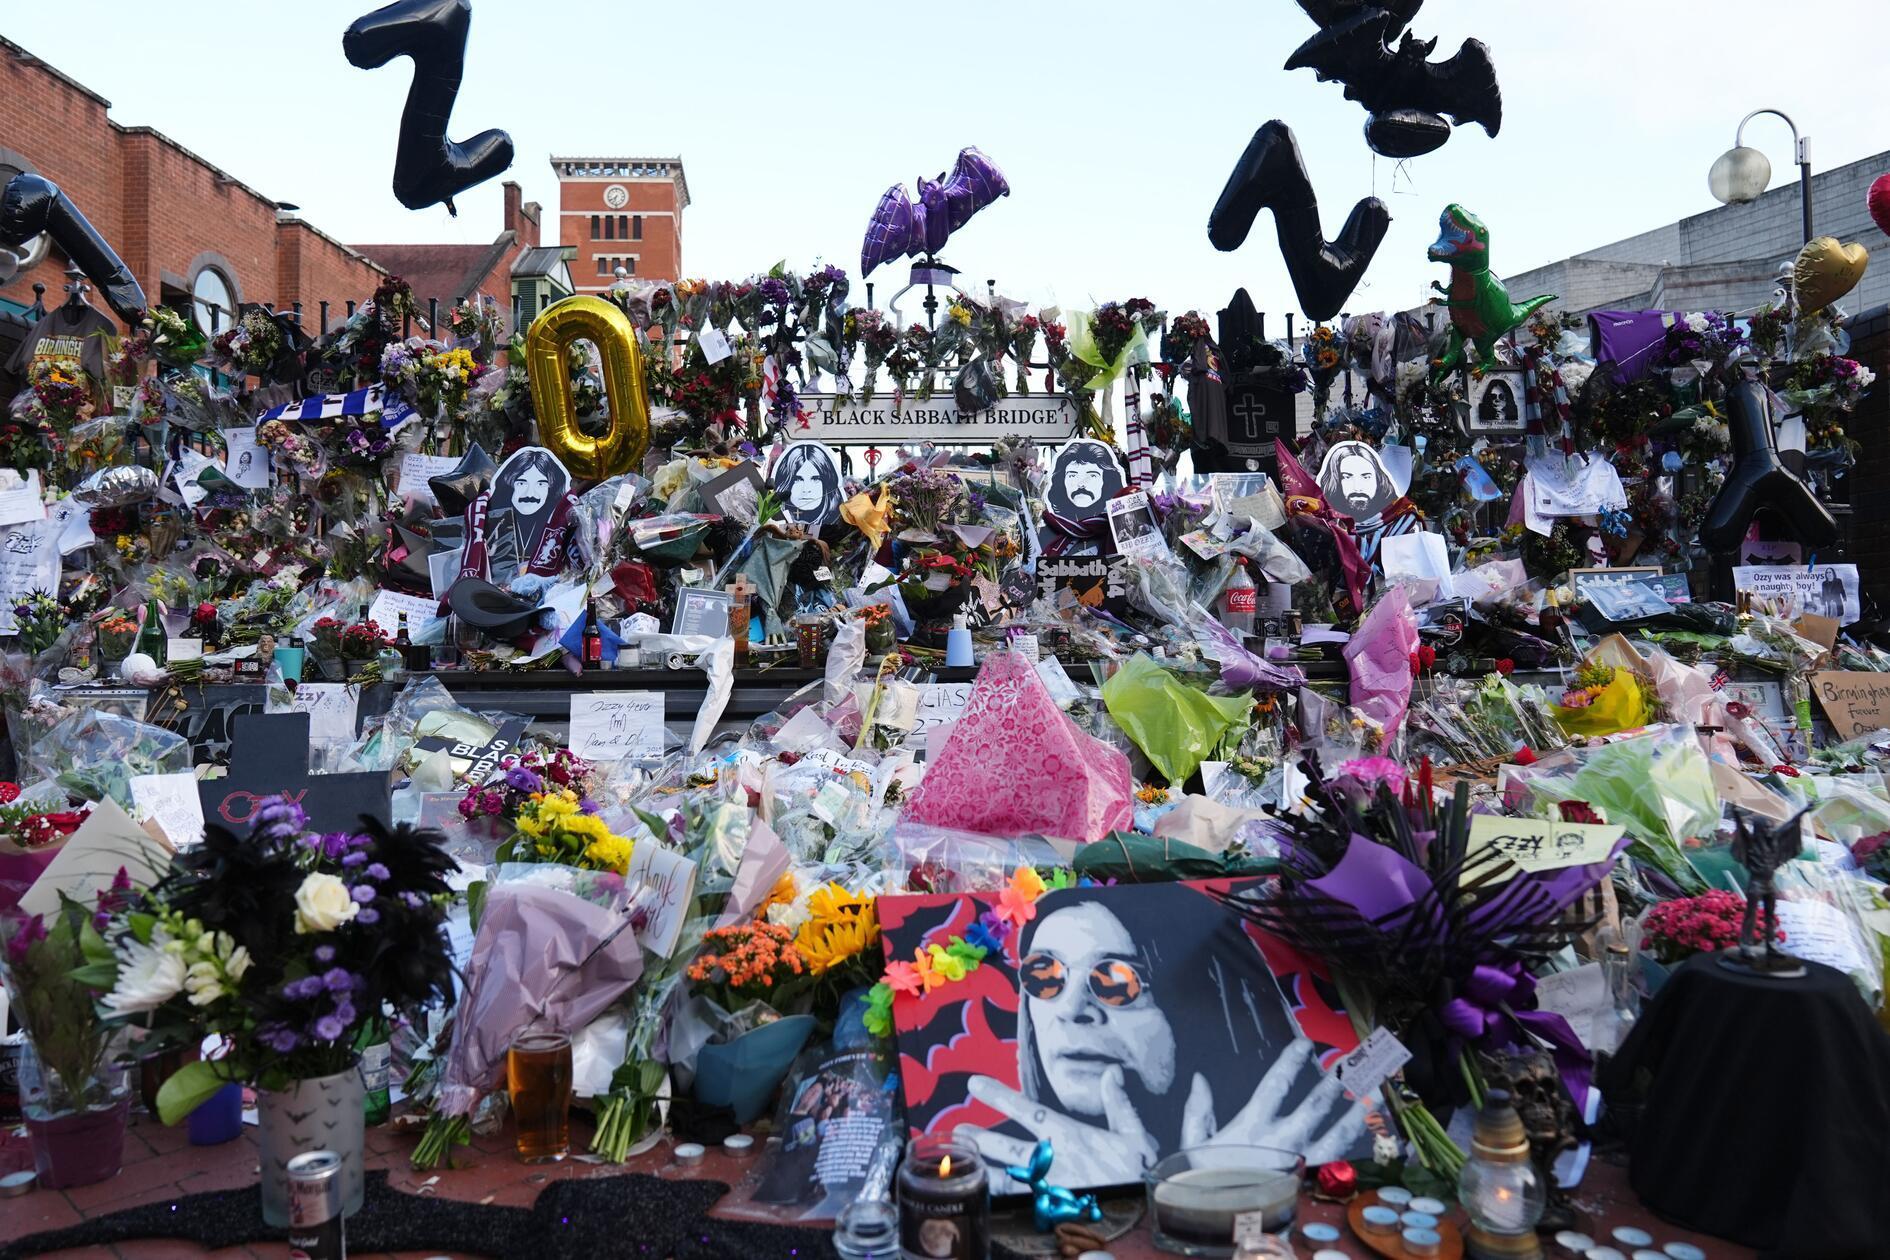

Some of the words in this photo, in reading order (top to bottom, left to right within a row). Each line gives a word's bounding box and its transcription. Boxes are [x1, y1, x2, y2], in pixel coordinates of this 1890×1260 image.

[823, 409, 886, 426] BLACK
[890, 409, 978, 426] SABBATH
[985, 409, 1058, 426] BRIDGE
[1037, 559, 1108, 577] Sabbath
[1753, 573, 1772, 582] Ozzy
[1796, 572, 1825, 582] always
[1760, 582, 1793, 592] naughty
[1796, 581, 1816, 592] boy!
[589, 700, 623, 714] Ozzy
[450, 743, 520, 768] BLAC
[218, 788, 309, 824] OY
